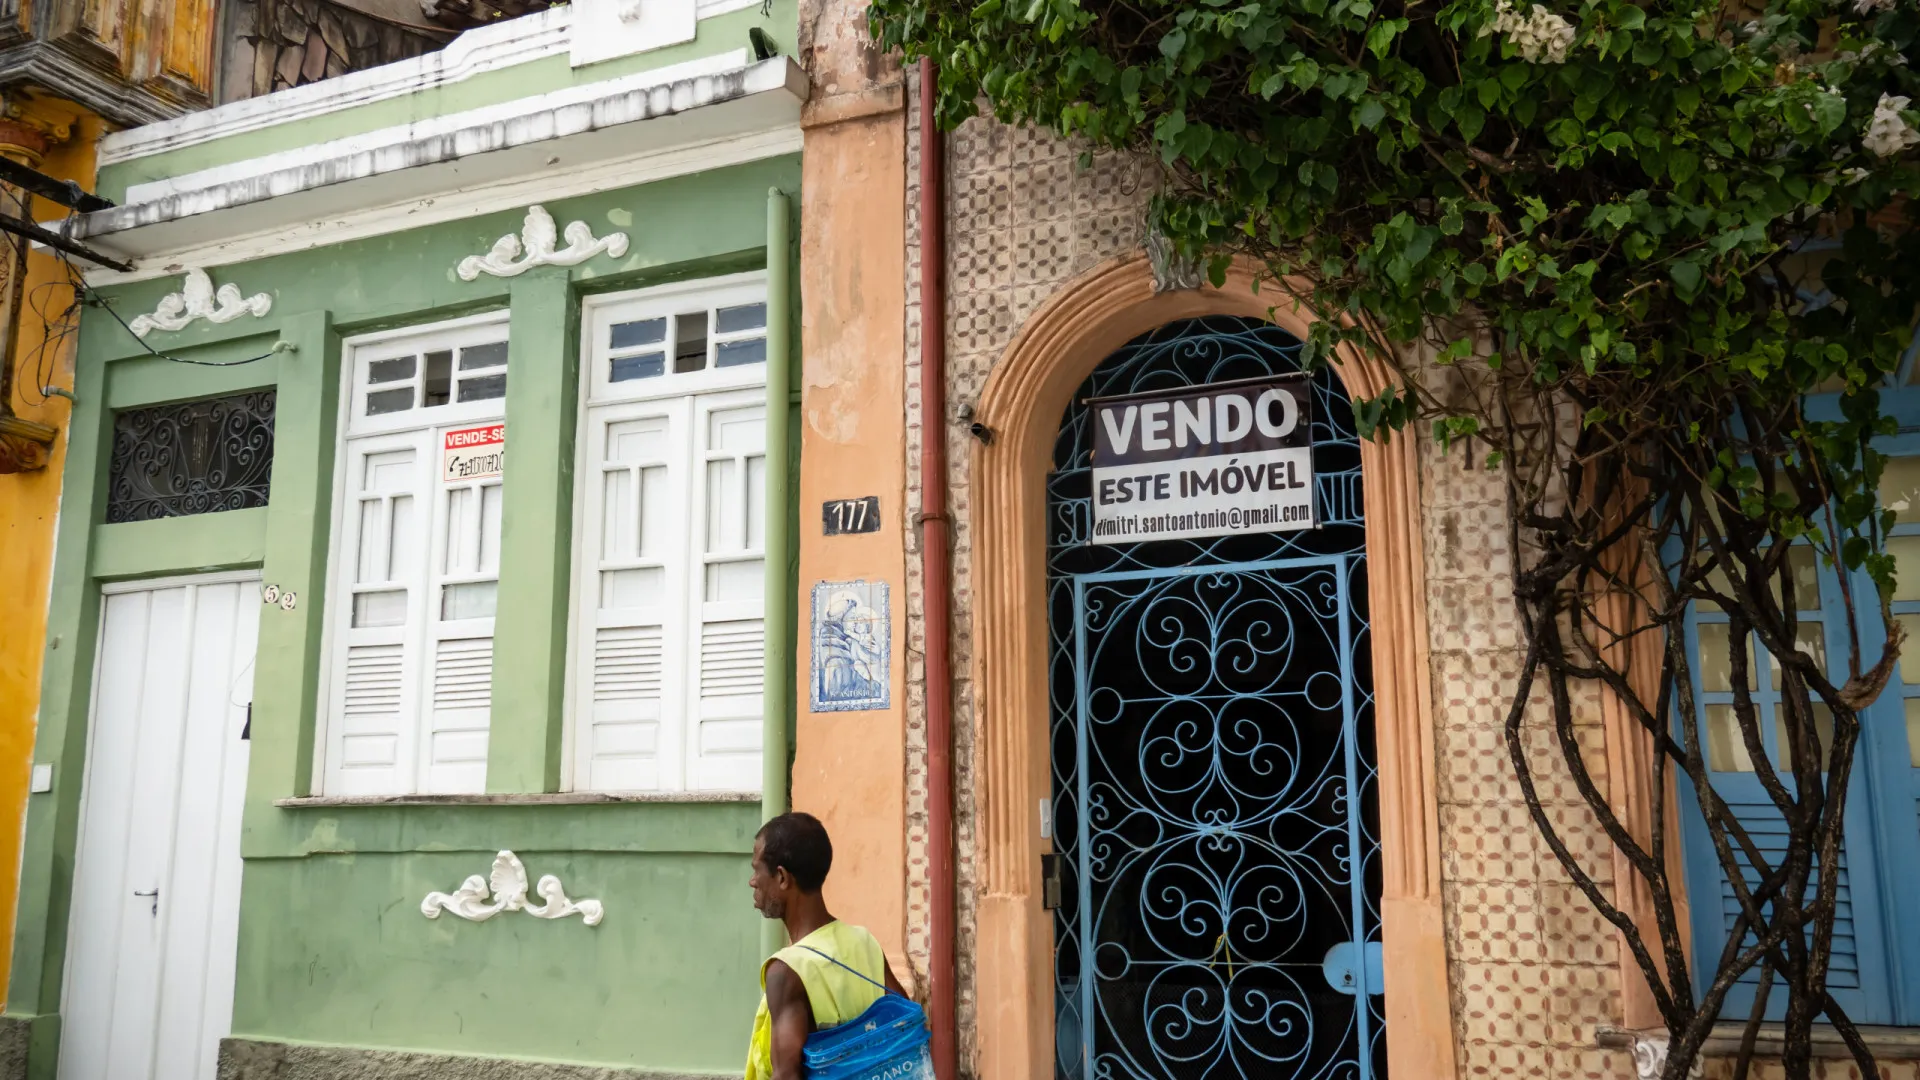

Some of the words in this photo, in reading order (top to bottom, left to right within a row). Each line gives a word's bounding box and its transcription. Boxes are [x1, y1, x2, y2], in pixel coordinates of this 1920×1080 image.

[1101, 388, 1298, 455] VENDO
[1100, 473, 1171, 505] ESTE
[1180, 458, 1305, 498] IMÓVEL
[832, 501, 868, 530] 177
[1095, 504, 1310, 536] dimitri.santoantonio@gmail.com
[265, 585, 295, 609] 52
